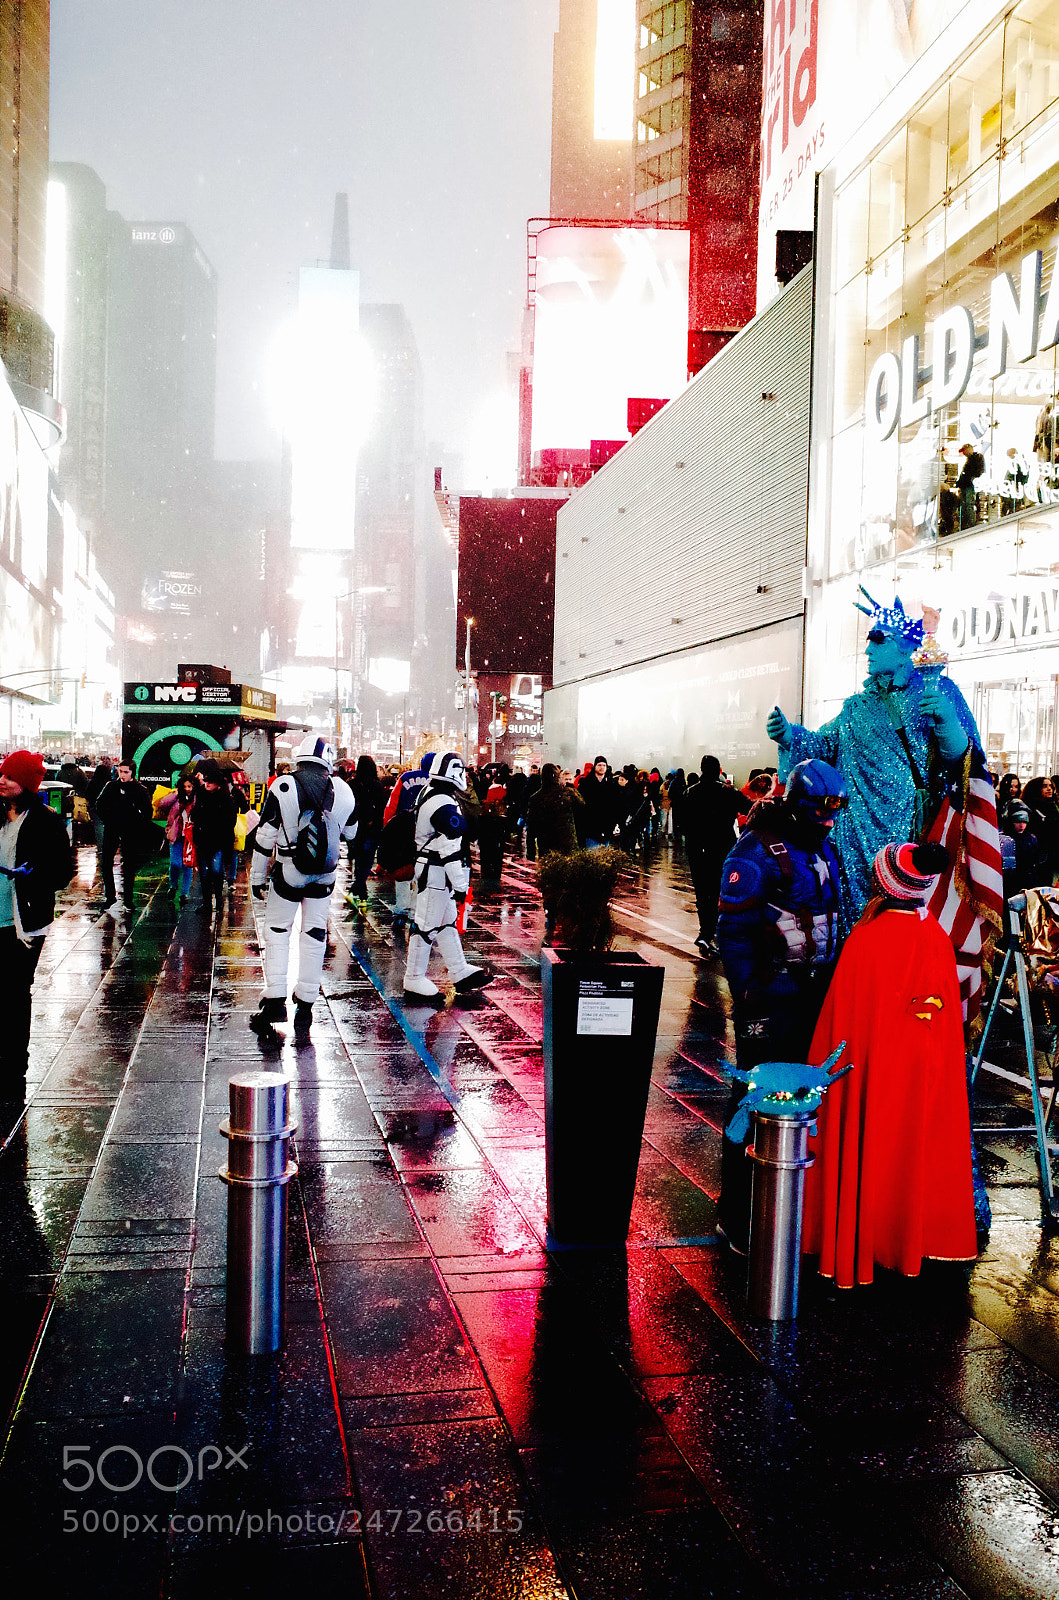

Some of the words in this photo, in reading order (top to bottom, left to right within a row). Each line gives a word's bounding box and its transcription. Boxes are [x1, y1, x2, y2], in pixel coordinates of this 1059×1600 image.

[782, 169, 793, 201] 25
[797, 121, 825, 178] DAYS
[866, 304, 973, 442] OLD
[158, 580, 202, 596] FROZEN
[946, 600, 1004, 649] OLD
[154, 686, 197, 702] NYC
